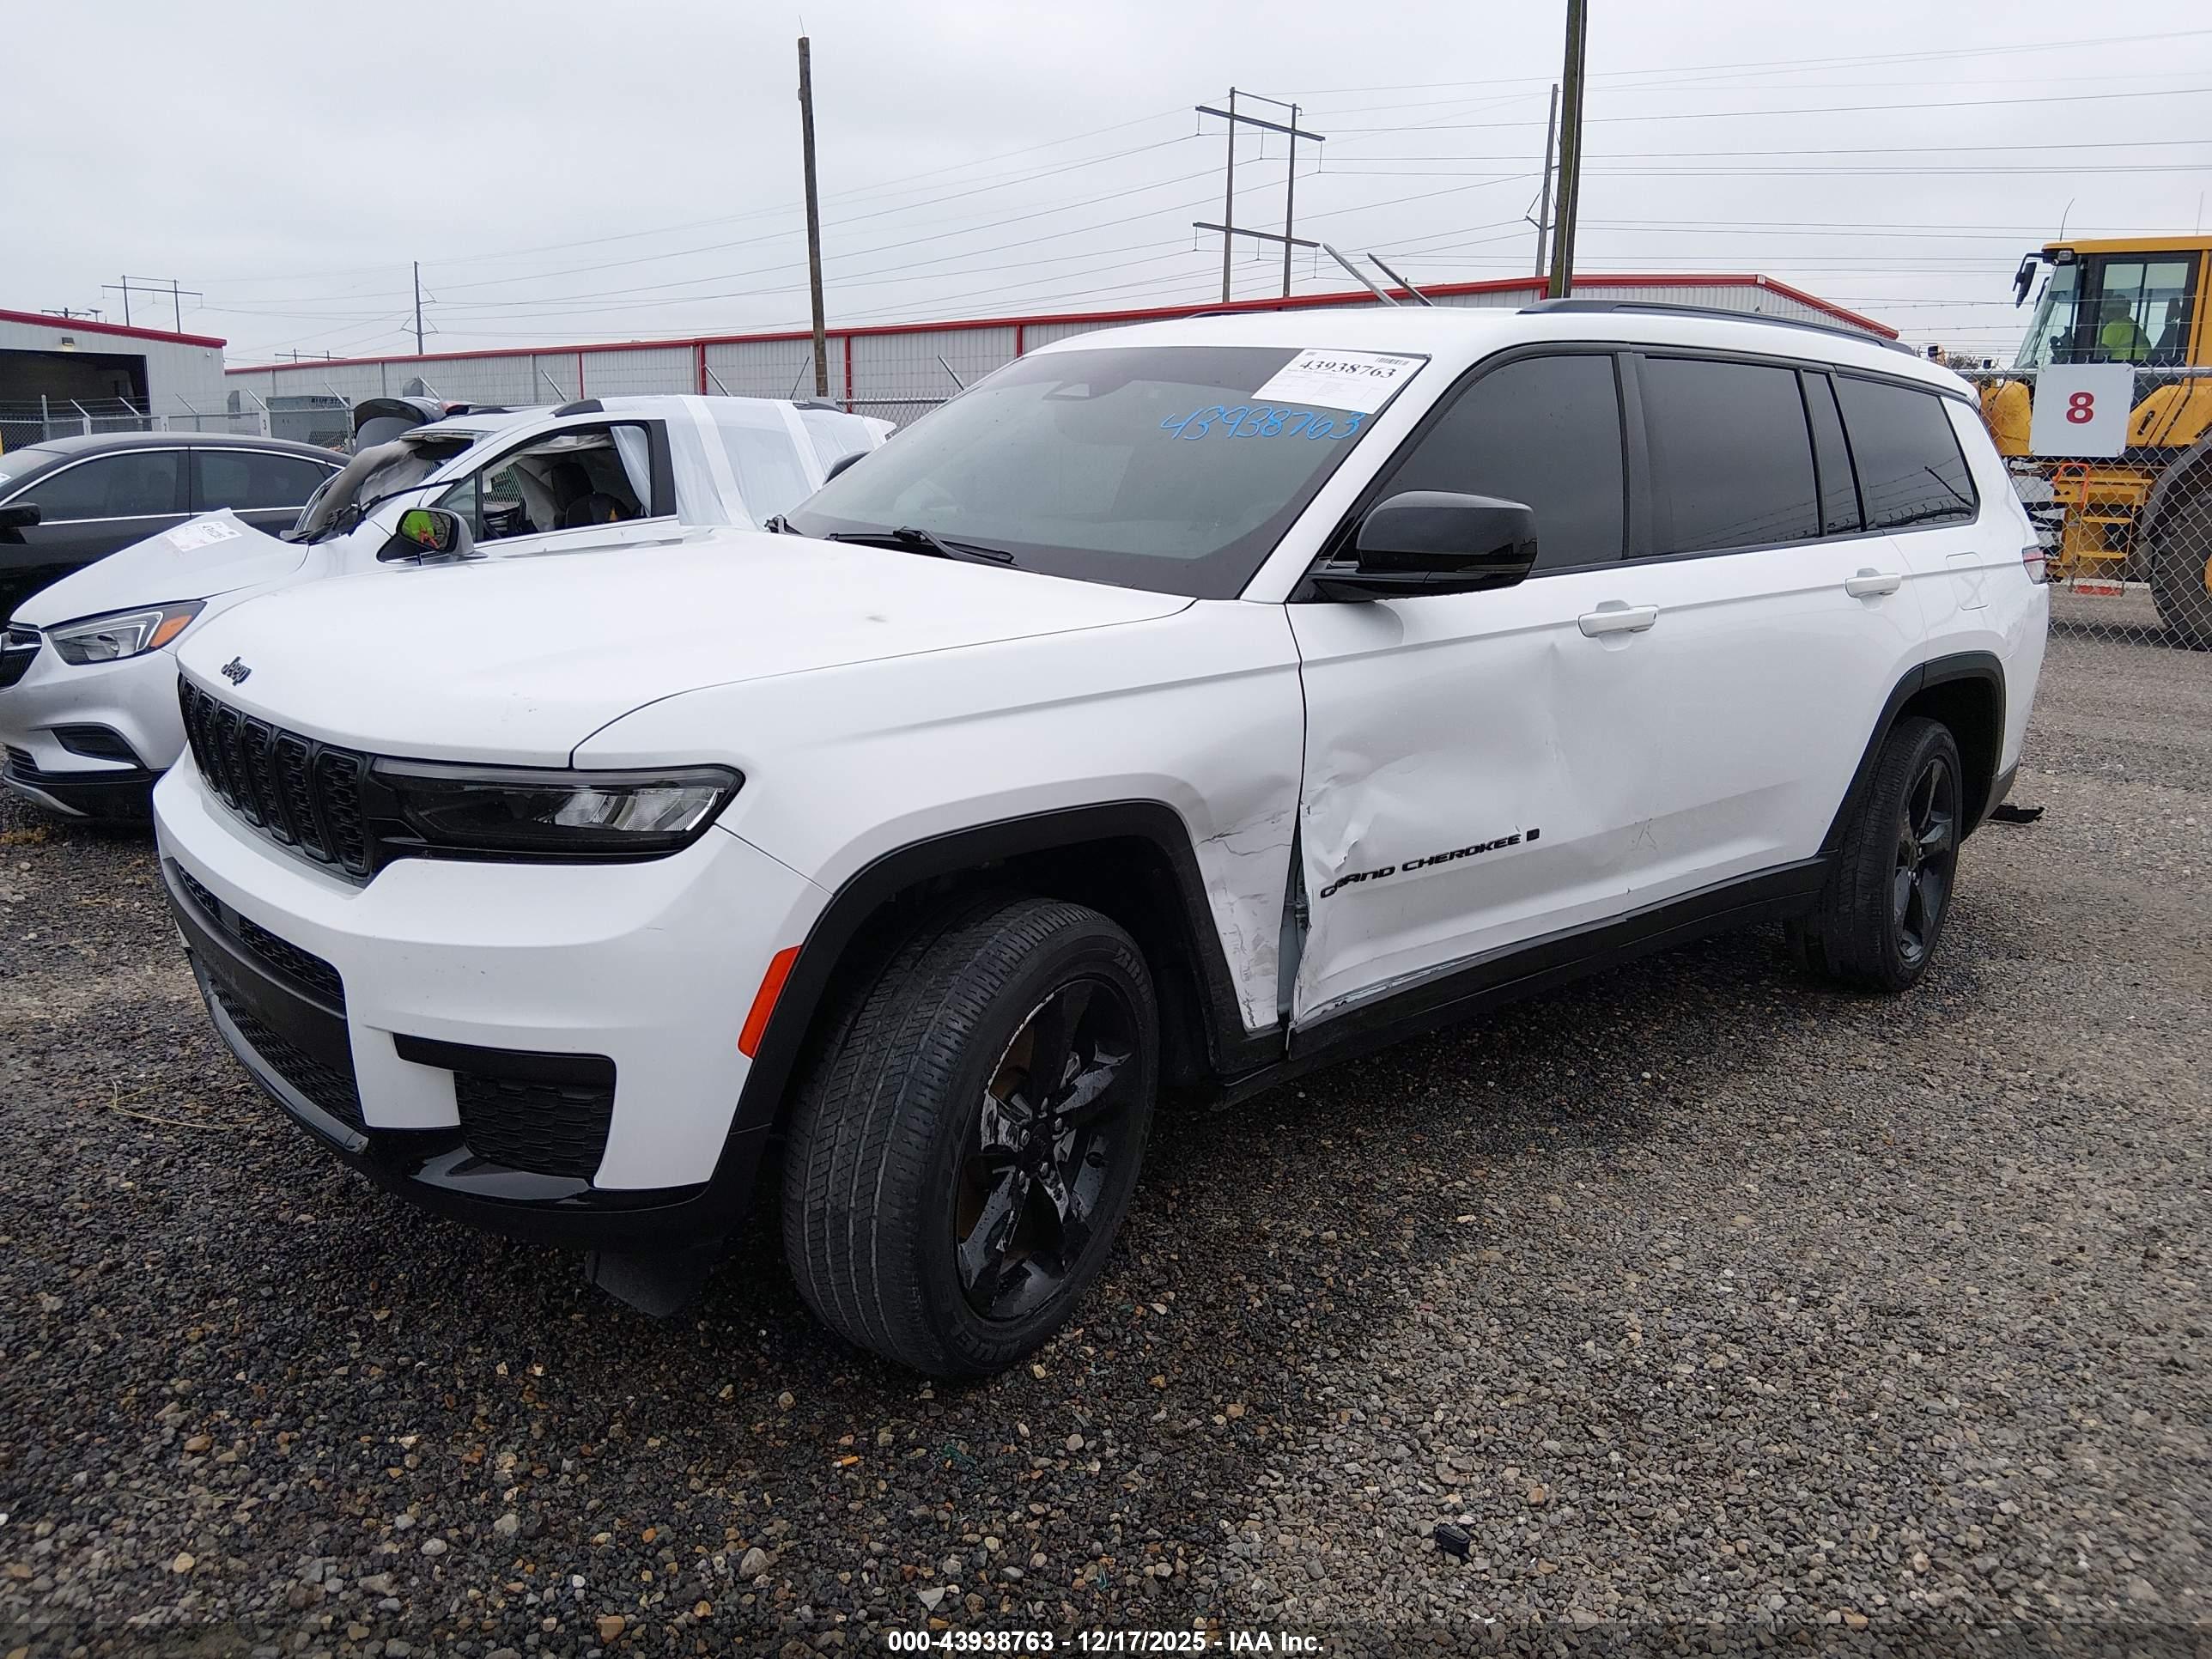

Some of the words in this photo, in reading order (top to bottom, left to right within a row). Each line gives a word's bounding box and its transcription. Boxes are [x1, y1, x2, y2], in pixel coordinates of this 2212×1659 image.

[1299, 359, 1397, 379] 43938763
[1161, 404, 1366, 441] 43938763
[2066, 392, 2094, 424] 8
[220, 655, 252, 687] Jeep
[1401, 833, 1522, 872] CHEROKEE
